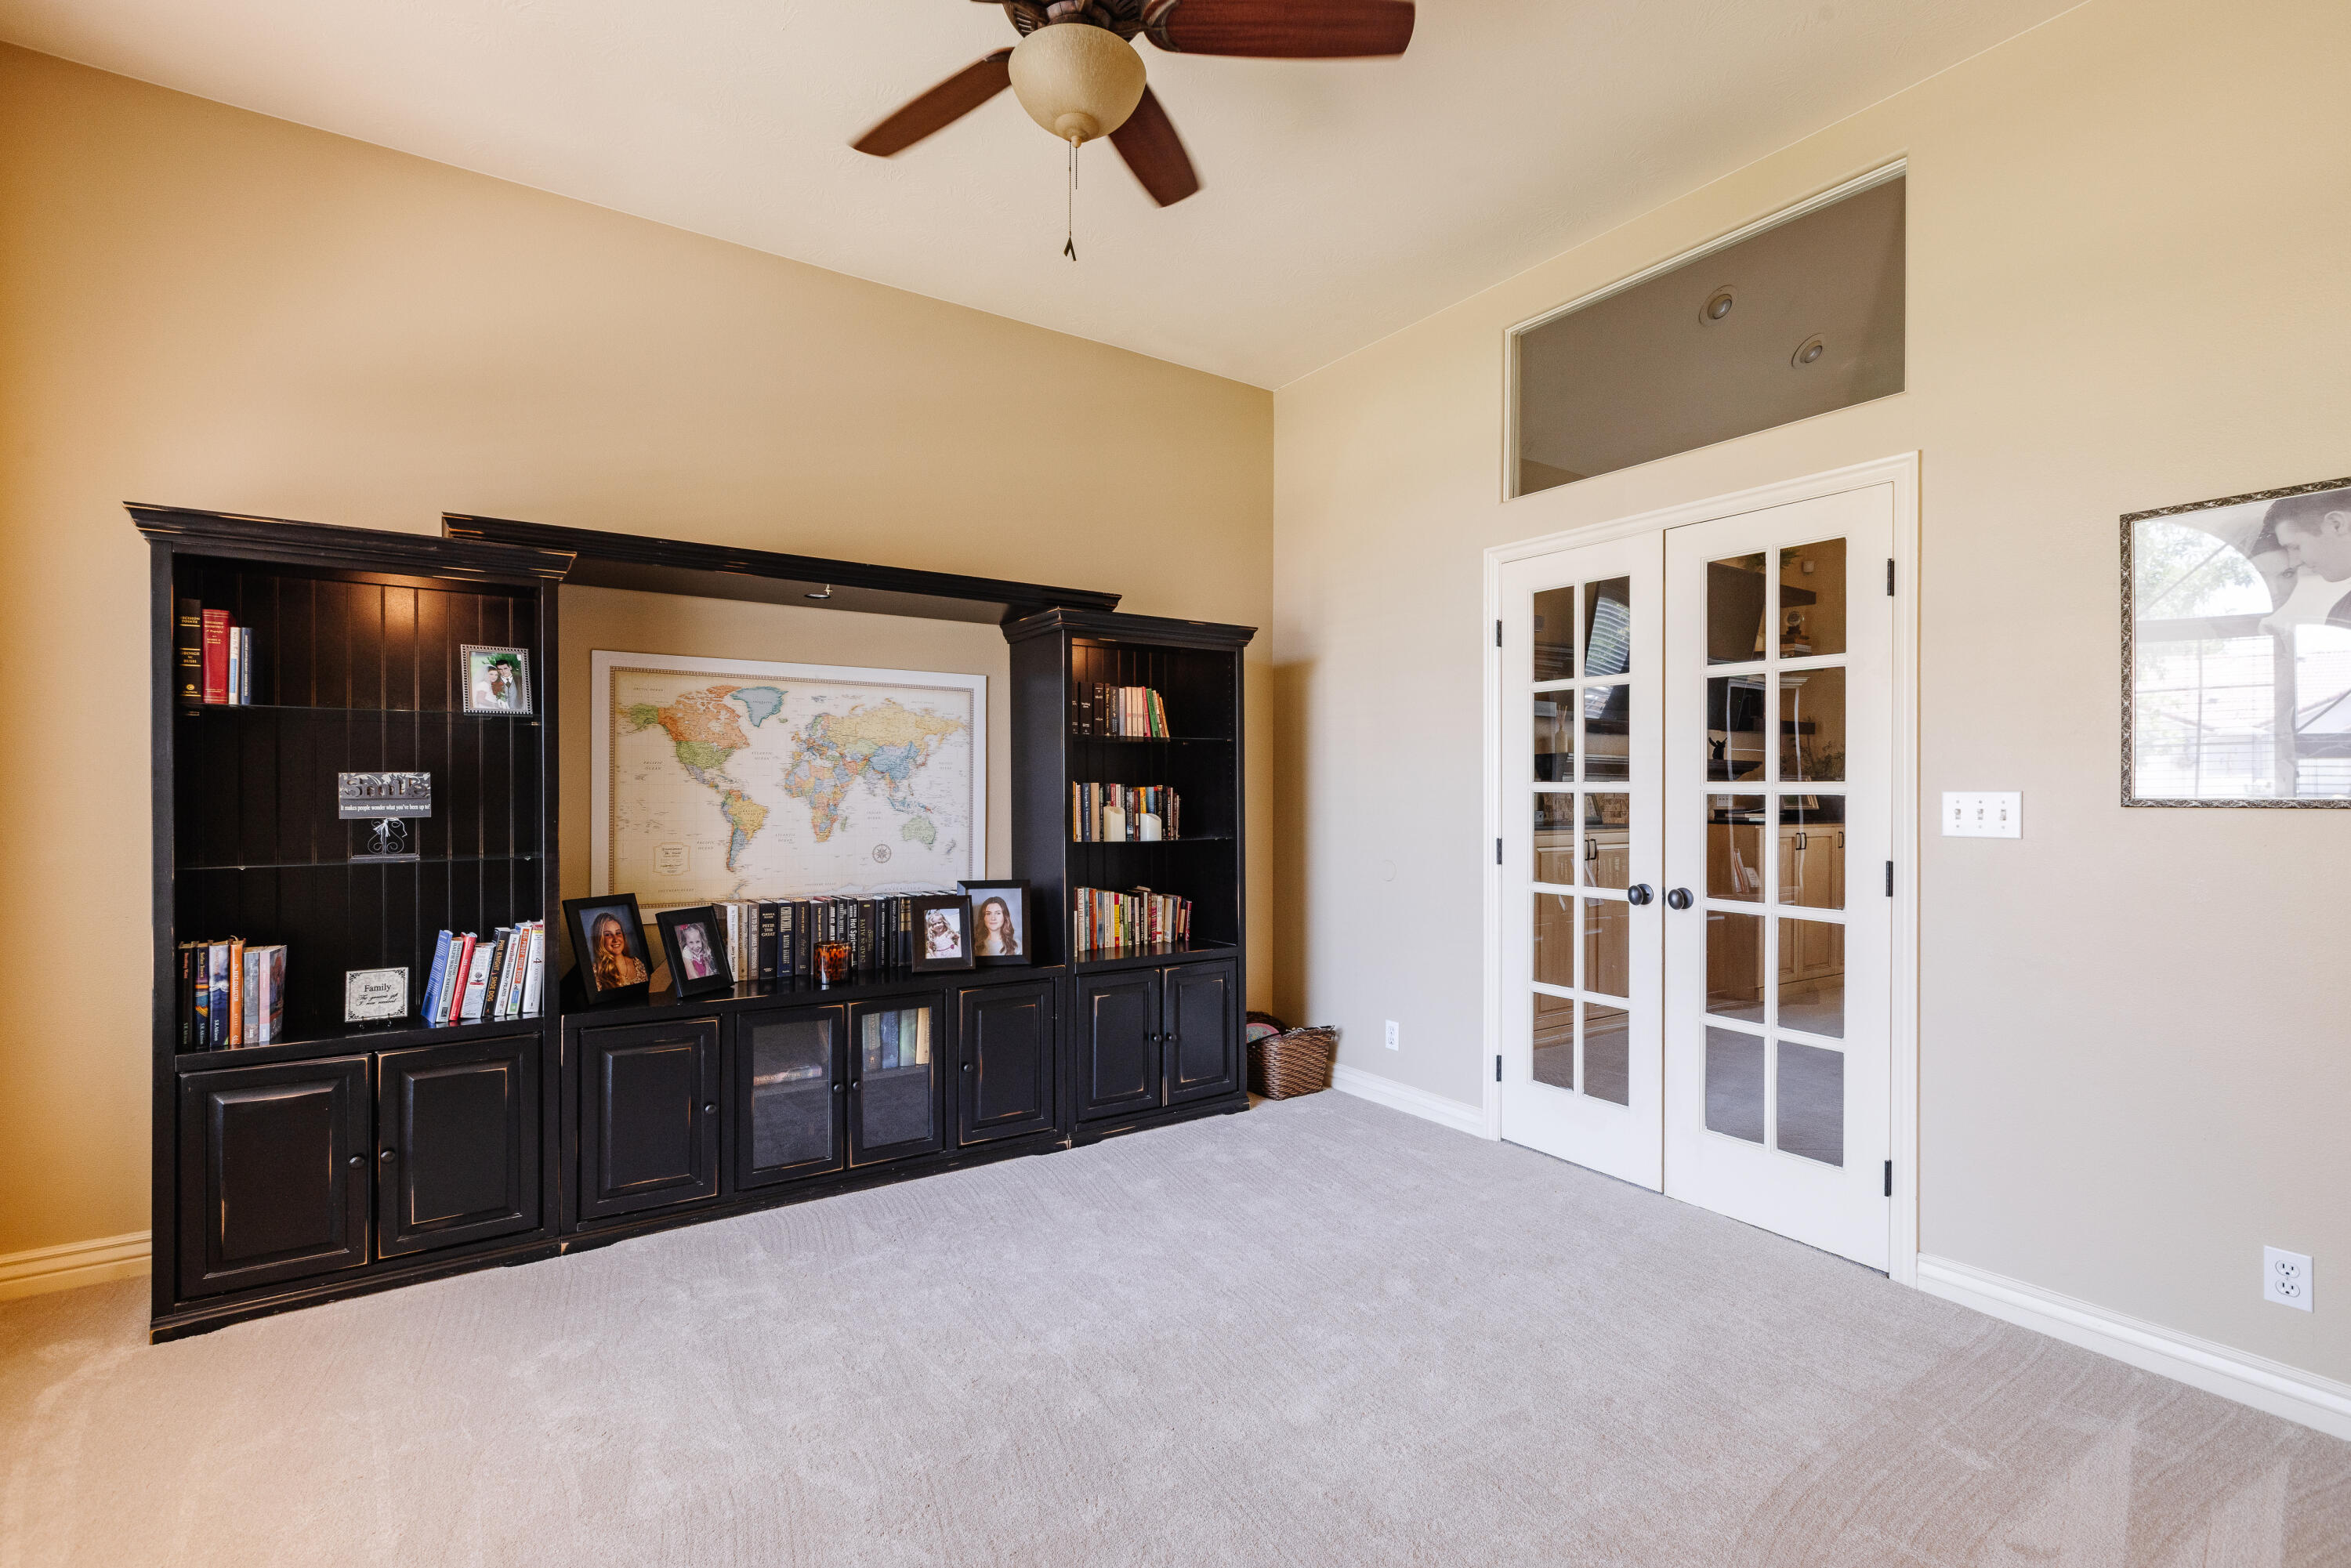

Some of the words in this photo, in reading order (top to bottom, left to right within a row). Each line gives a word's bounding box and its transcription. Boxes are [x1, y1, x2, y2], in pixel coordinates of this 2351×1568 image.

[346, 777, 429, 798] Smile
[1078, 889, 1084, 900] ON
[780, 907, 792, 932] CHURCHILL
[454, 943, 462, 965] Selections
[497, 940, 505, 951] PHIL
[493, 951, 502, 972] KNIGHT
[364, 983, 392, 992] Family
[442, 978, 451, 1002] EMERSON
[489, 976, 498, 990] SHOE
[487, 990, 495, 1002] DOG
